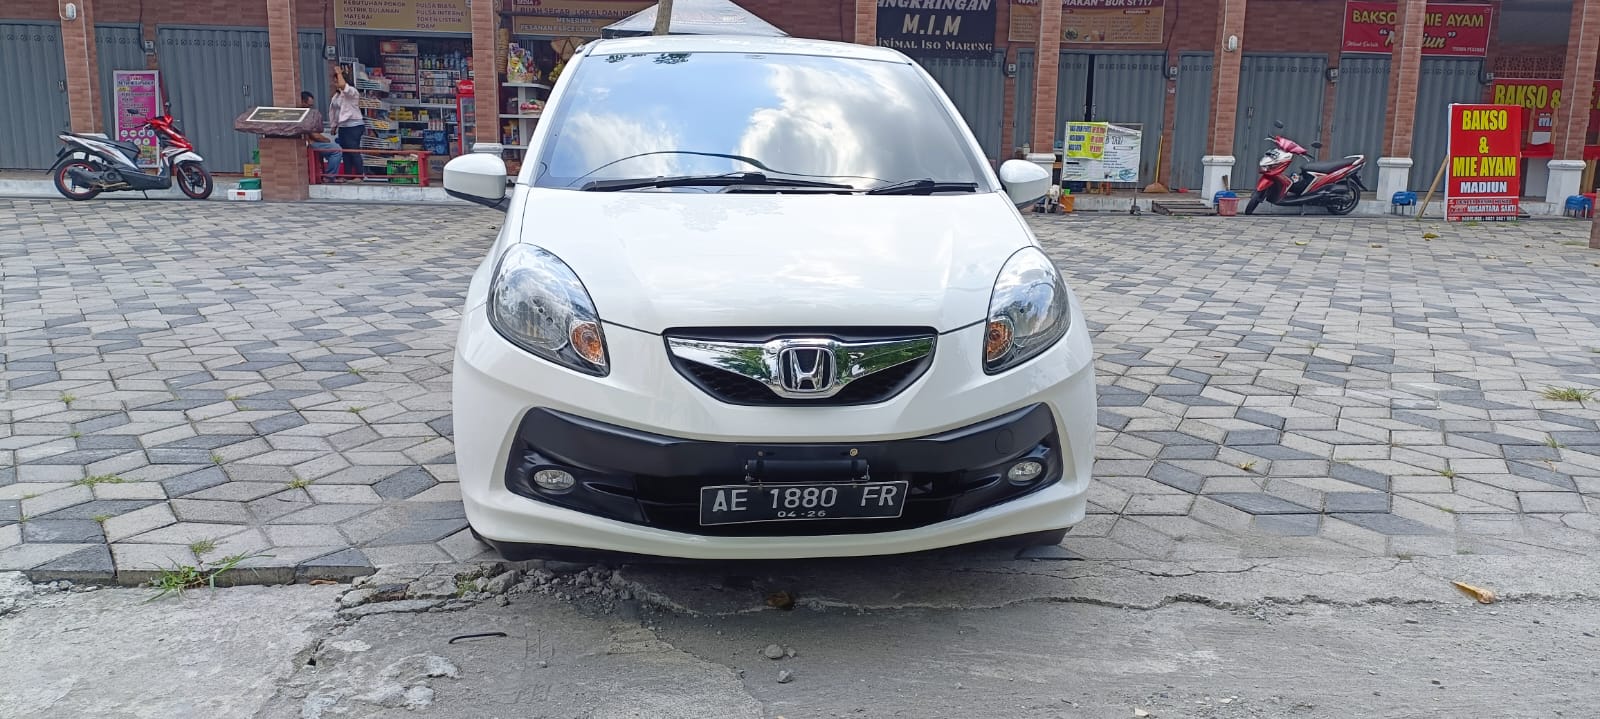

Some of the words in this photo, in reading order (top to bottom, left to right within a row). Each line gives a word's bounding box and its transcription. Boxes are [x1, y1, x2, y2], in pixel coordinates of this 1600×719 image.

[878, 0, 991, 11] NGKRINGAN
[902, 13, 962, 36] M.I.M
[1352, 10, 1397, 25] BAKSO
[1446, 14, 1484, 27] AYAM
[1494, 84, 1548, 109] BAKSO
[1462, 109, 1508, 131] BAKSO
[1478, 136, 1489, 154] &
[1452, 156, 1478, 178] MIE
[1479, 156, 1517, 178] AYAM
[1460, 181, 1508, 194] MADIUN
[712, 489, 748, 512] AE
[769, 486, 838, 509] 1880
[860, 485, 897, 507] FR
